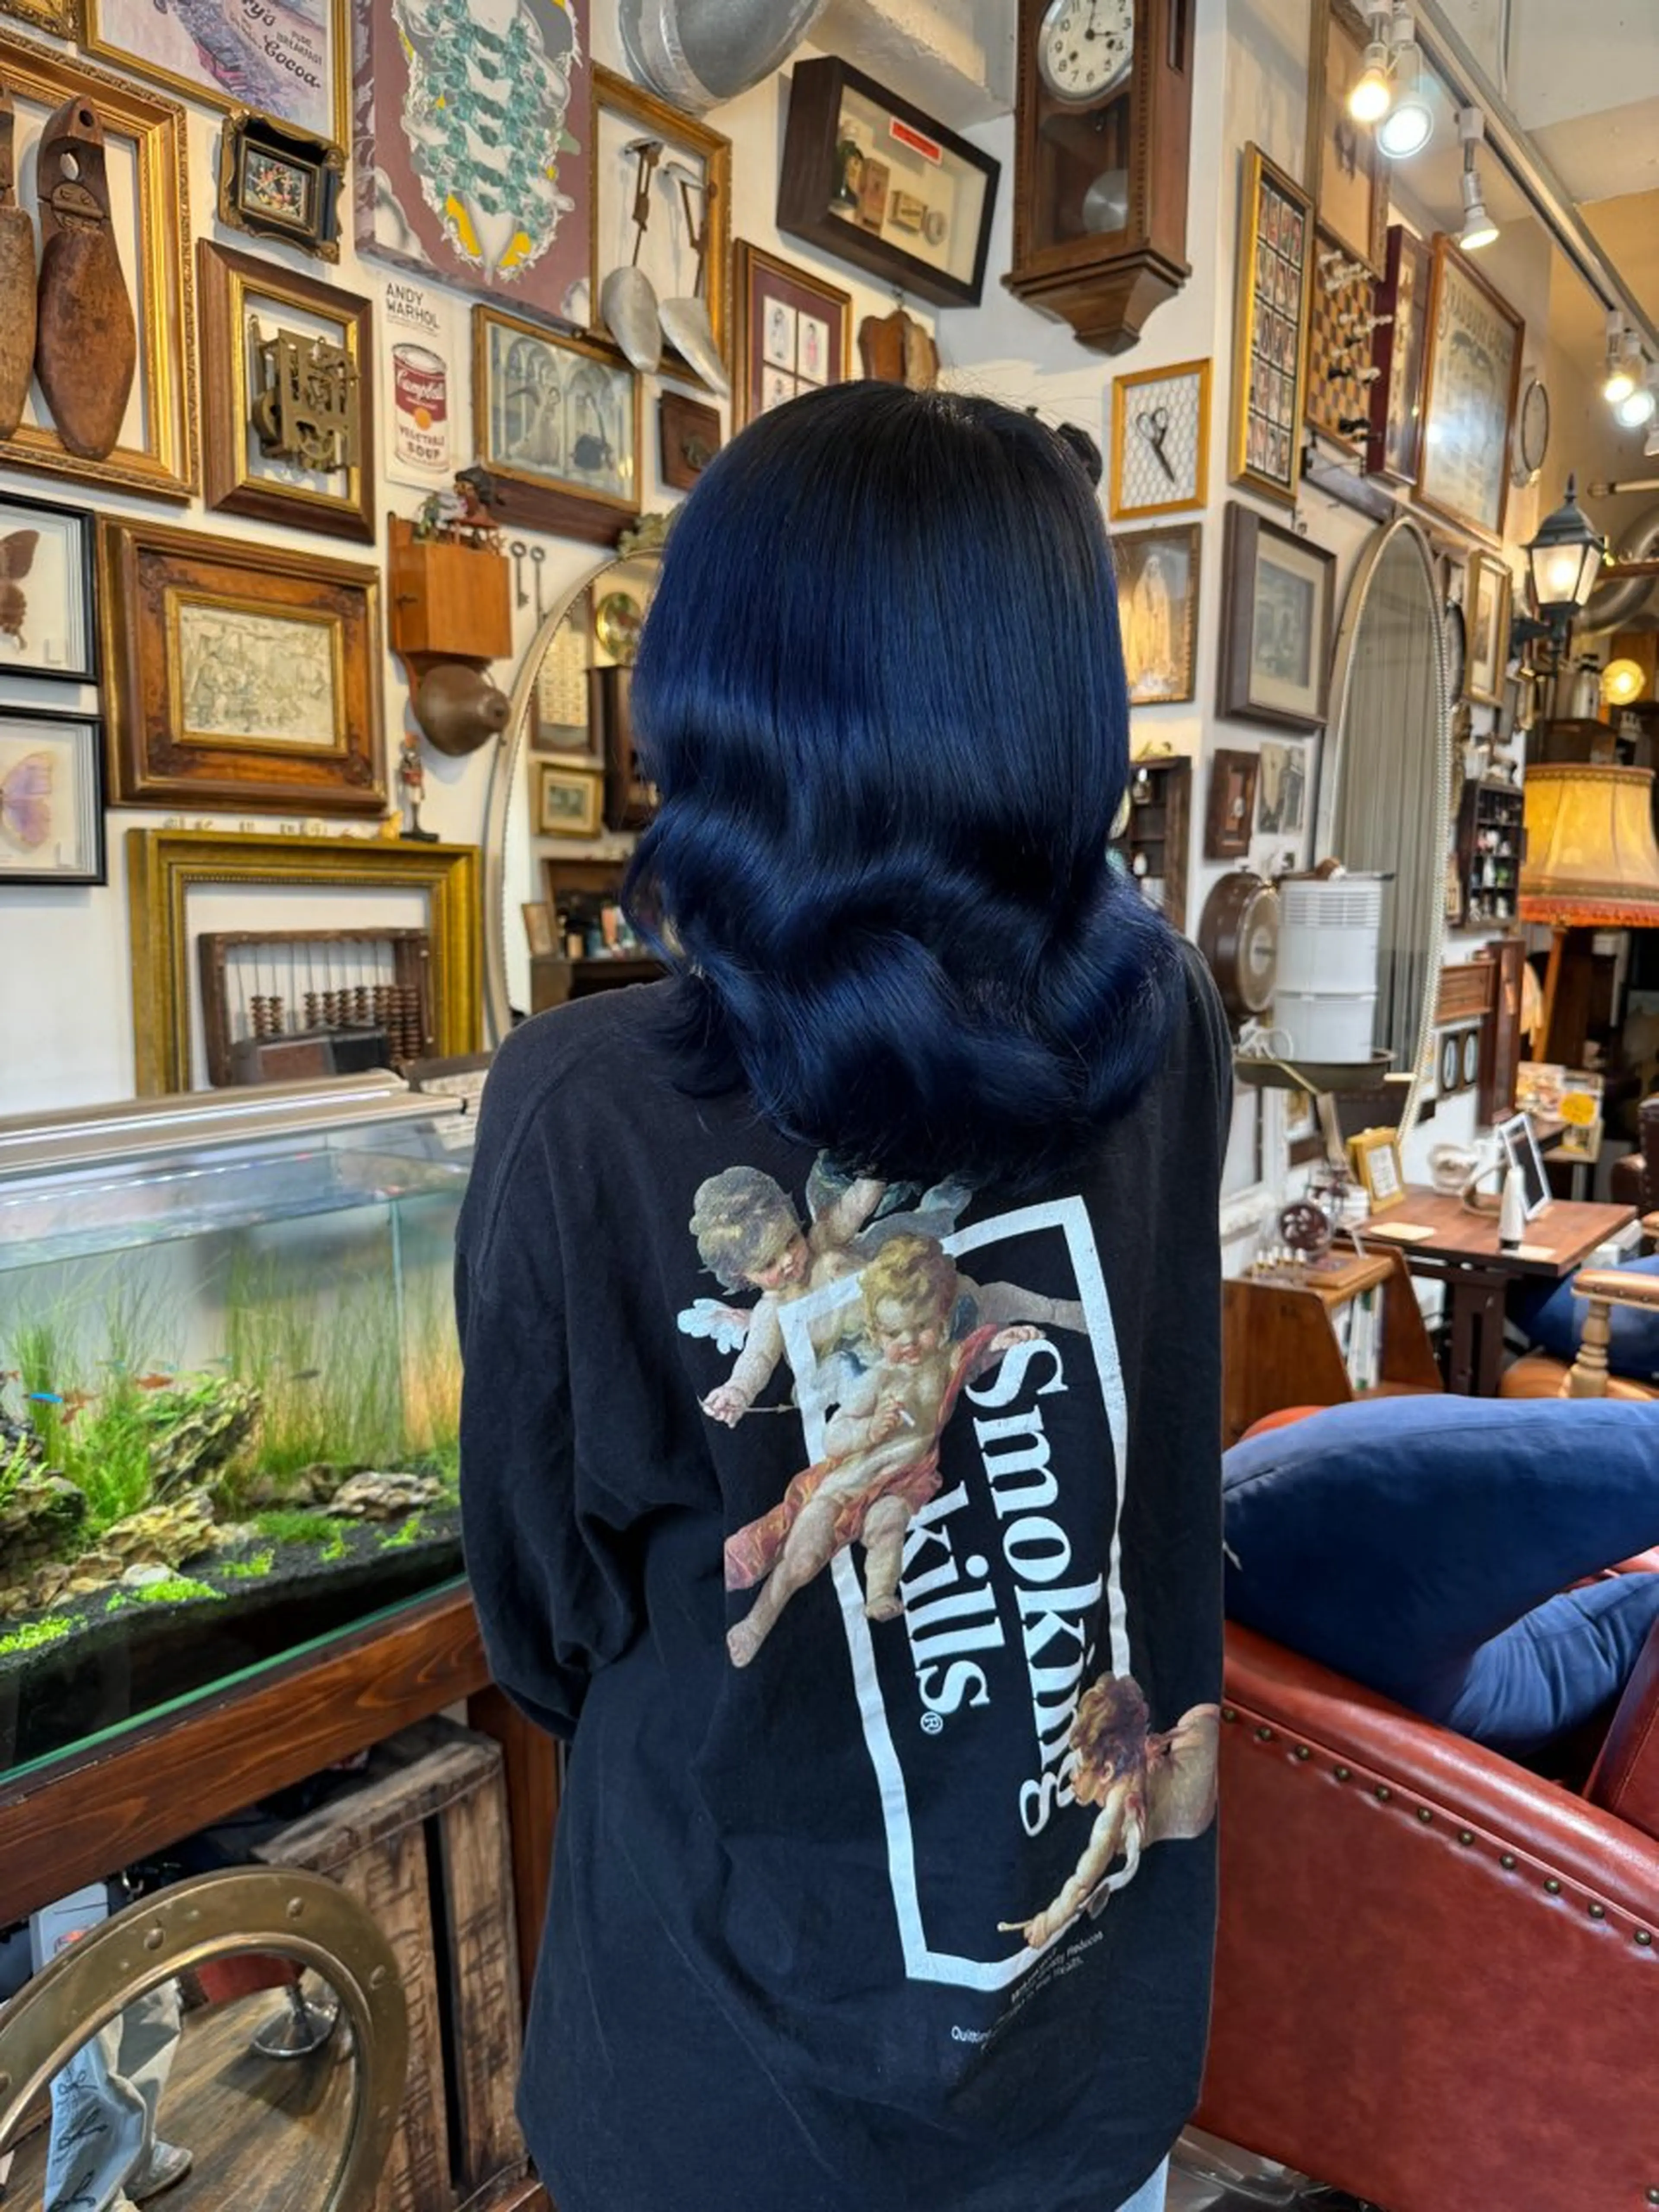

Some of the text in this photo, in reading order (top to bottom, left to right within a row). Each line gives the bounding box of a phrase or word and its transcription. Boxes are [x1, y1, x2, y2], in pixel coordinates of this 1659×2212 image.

[1055, 40, 1063, 54] 9
[263, 35, 321, 88] Cocoa
[1058, 59, 1068, 73] 8
[1086, 70, 1095, 83] 6
[386, 282, 424, 306] ANDY
[386, 298, 441, 330] WARHOL
[407, 442, 440, 460] SOUP
